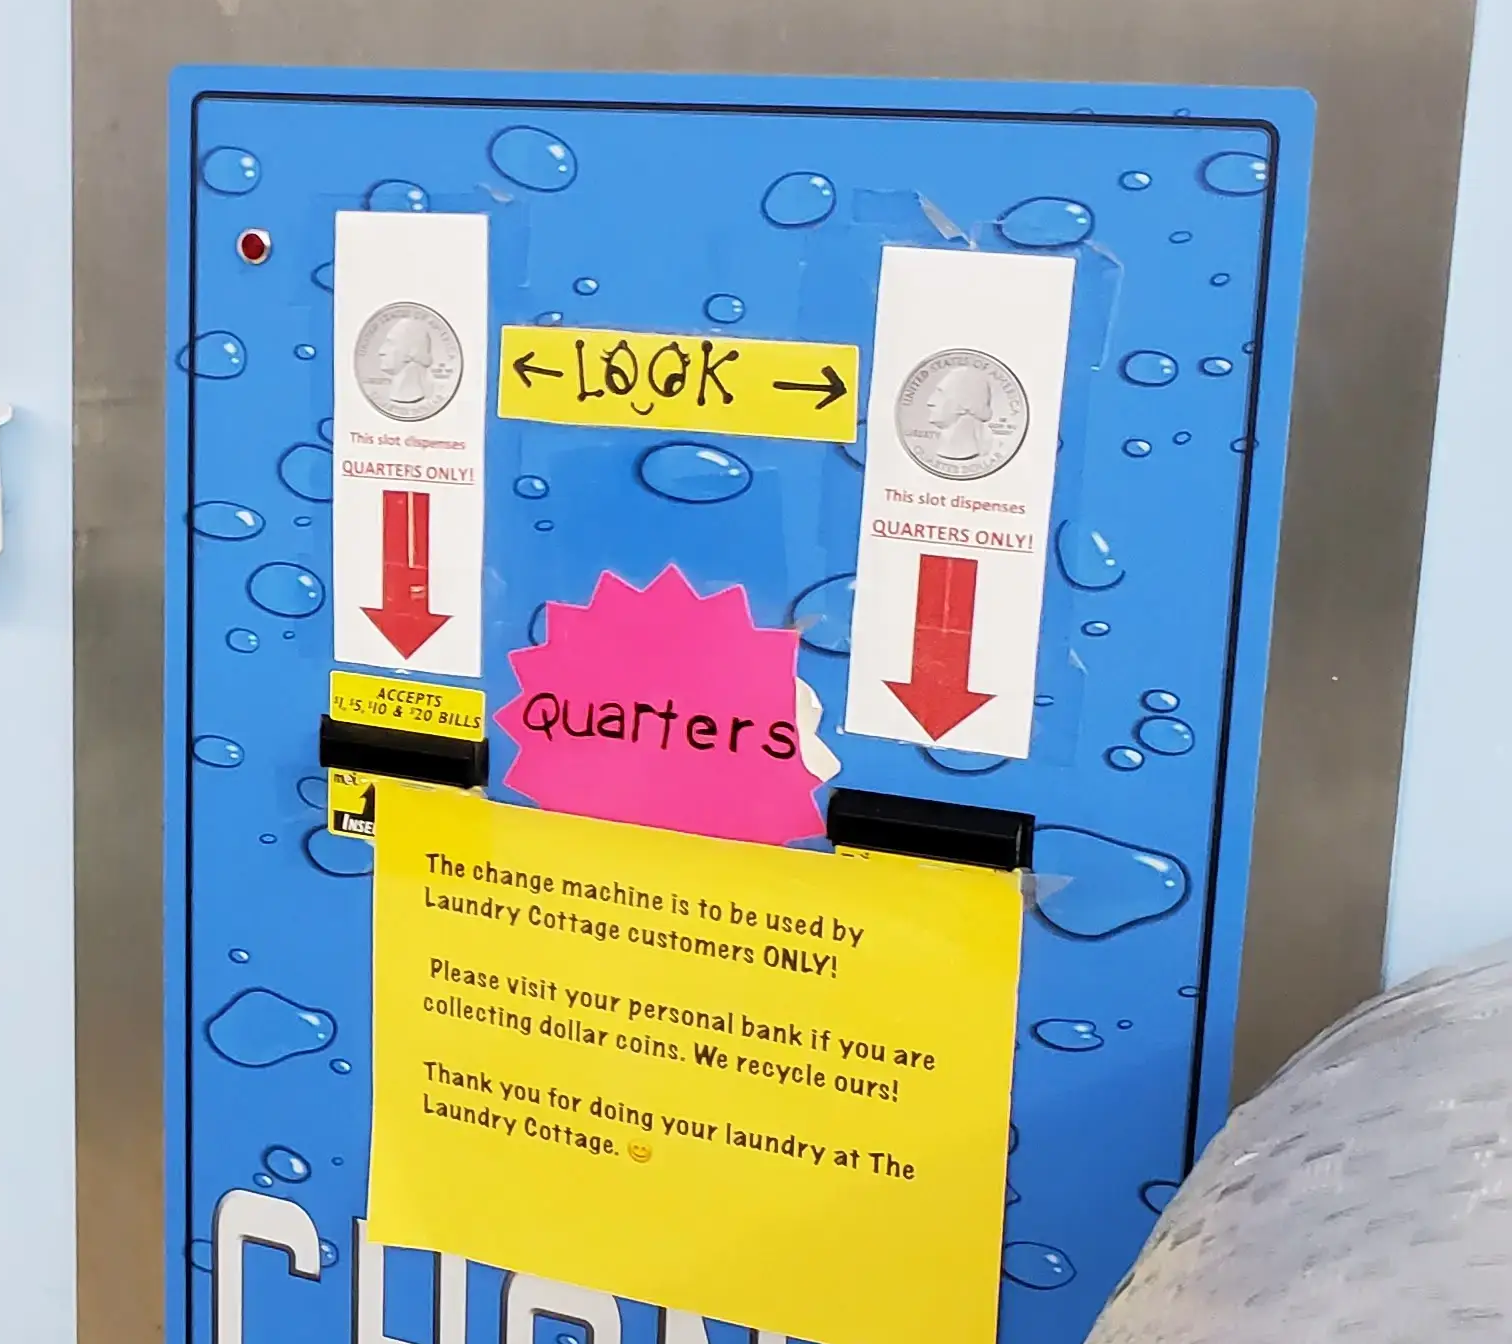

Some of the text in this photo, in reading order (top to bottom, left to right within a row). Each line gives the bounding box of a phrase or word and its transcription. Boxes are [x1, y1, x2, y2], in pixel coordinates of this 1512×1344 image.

[574, 337, 742, 409] LOOK
[342, 460, 474, 482] QUARTERS ONLY!
[885, 488, 1026, 514] This slot dispenses
[872, 519, 1033, 549] QUARTERS ONLY!
[377, 688, 443, 708] ACCEPTS
[392, 706, 404, 718] &
[438, 712, 481, 729] BILLS
[522, 692, 798, 761] Quarters
[424, 886, 837, 979] Laundry Cottage customers ONLY!
[426, 853, 864, 948] The change machine is to be used by
[429, 957, 936, 1071] Please visit your personal bank if you are
[423, 995, 899, 1103] collecting dollar coins. We recycle ours!
[423, 1061, 917, 1182] Thank you for doing your laundry at The
[423, 1094, 620, 1156] Laundry Cottage.
